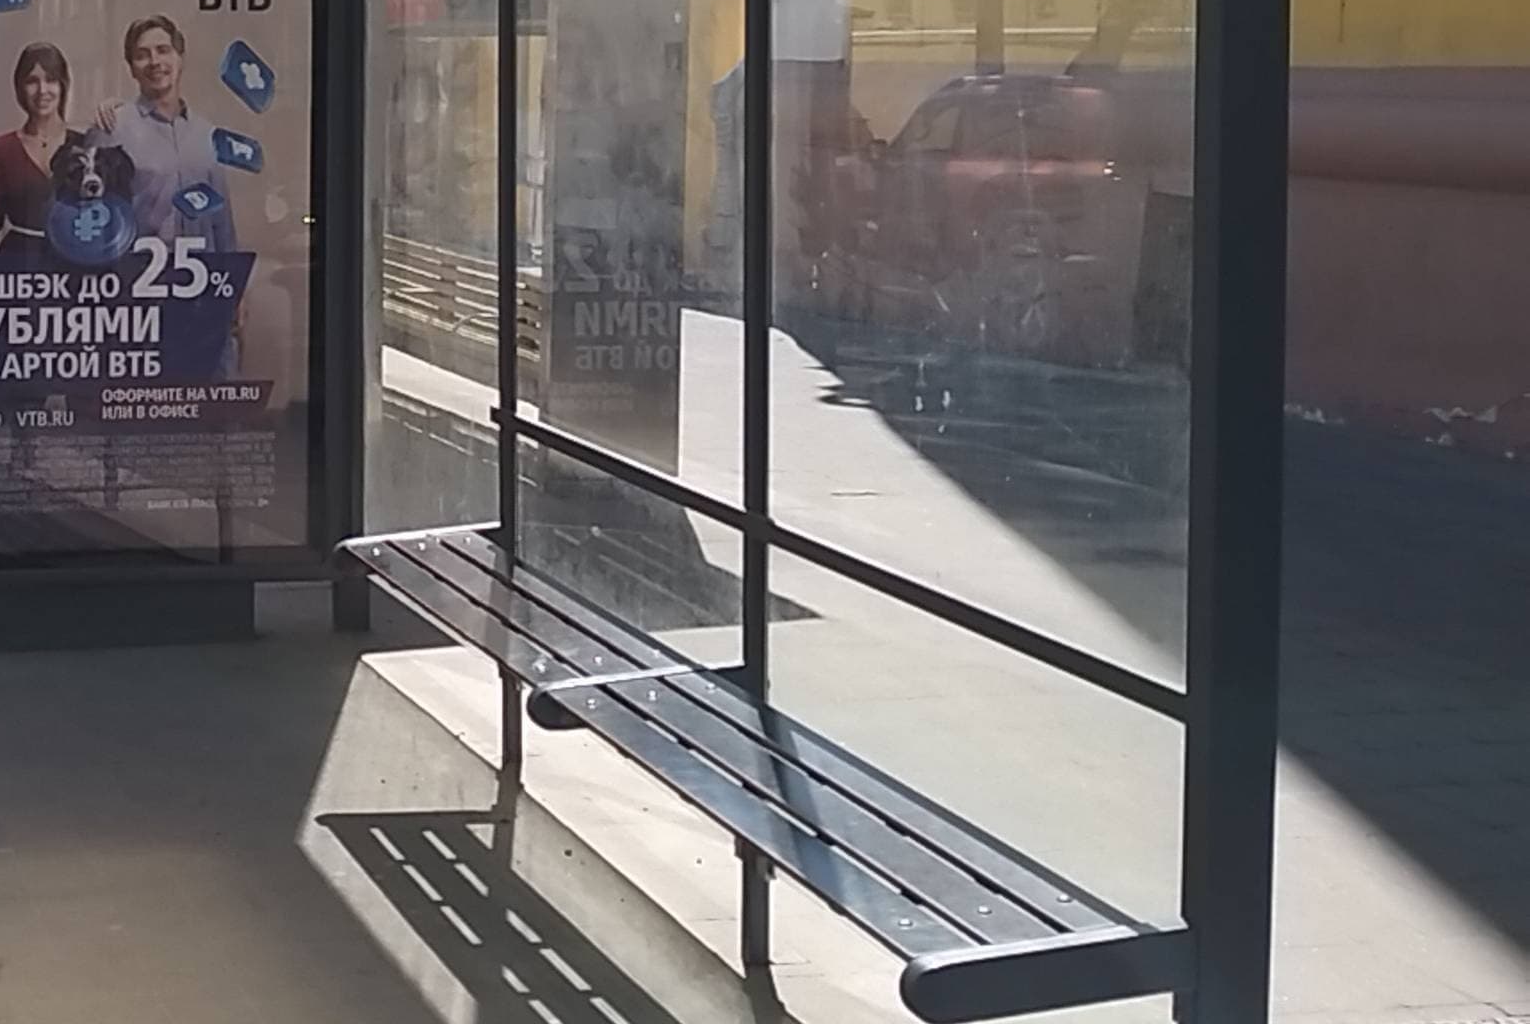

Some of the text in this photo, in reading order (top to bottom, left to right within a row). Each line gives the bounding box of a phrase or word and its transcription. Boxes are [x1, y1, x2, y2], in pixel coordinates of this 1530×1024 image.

[78, 273, 120, 303] ДО
[132, 236, 234, 299] 25%
[109, 350, 162, 378] ВТБ
[101, 386, 260, 403] ОФОРМИТЕ НА VTB.RU
[16, 411, 74, 428] VTB.RU
[101, 404, 200, 420] ИЛИ В ОФИСЕ
